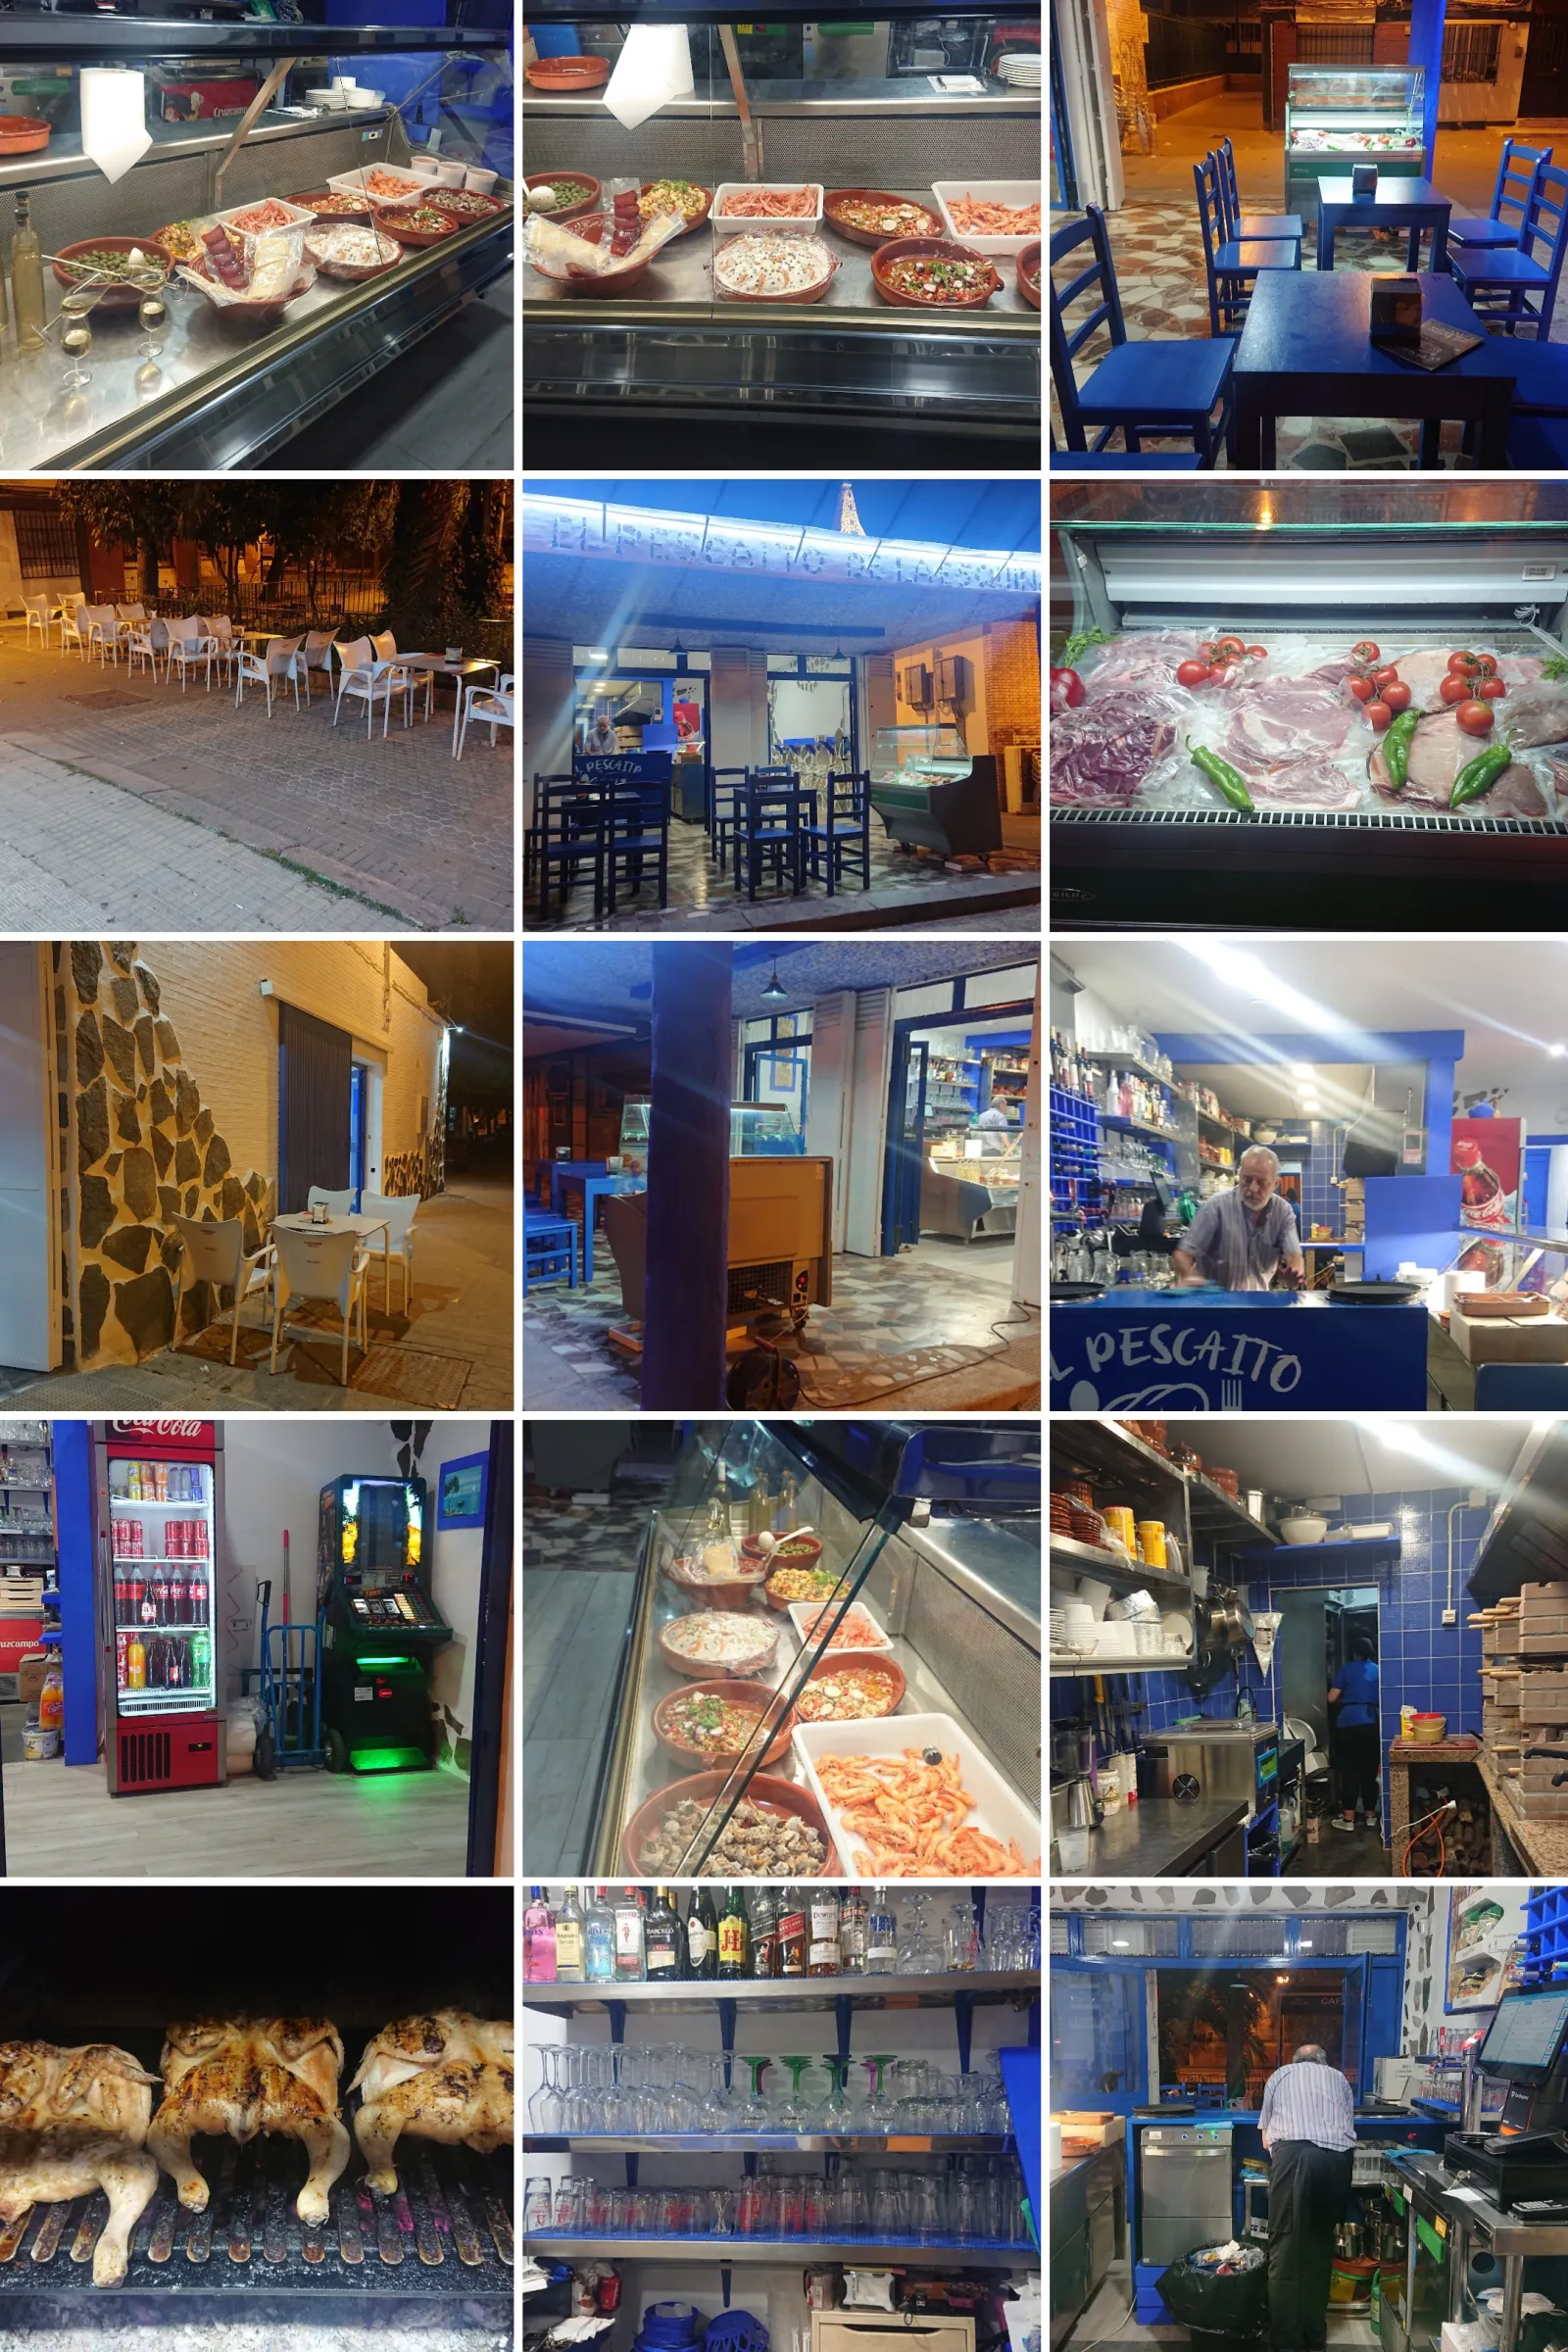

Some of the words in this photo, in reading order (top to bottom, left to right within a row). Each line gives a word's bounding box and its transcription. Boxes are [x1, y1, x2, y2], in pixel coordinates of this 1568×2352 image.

[213, 107, 250, 118] Cruzcamp
[552, 515, 605, 551] EL
[1050, 1348, 1074, 1382] L
[1085, 1323, 1302, 1393] PESCAITO
